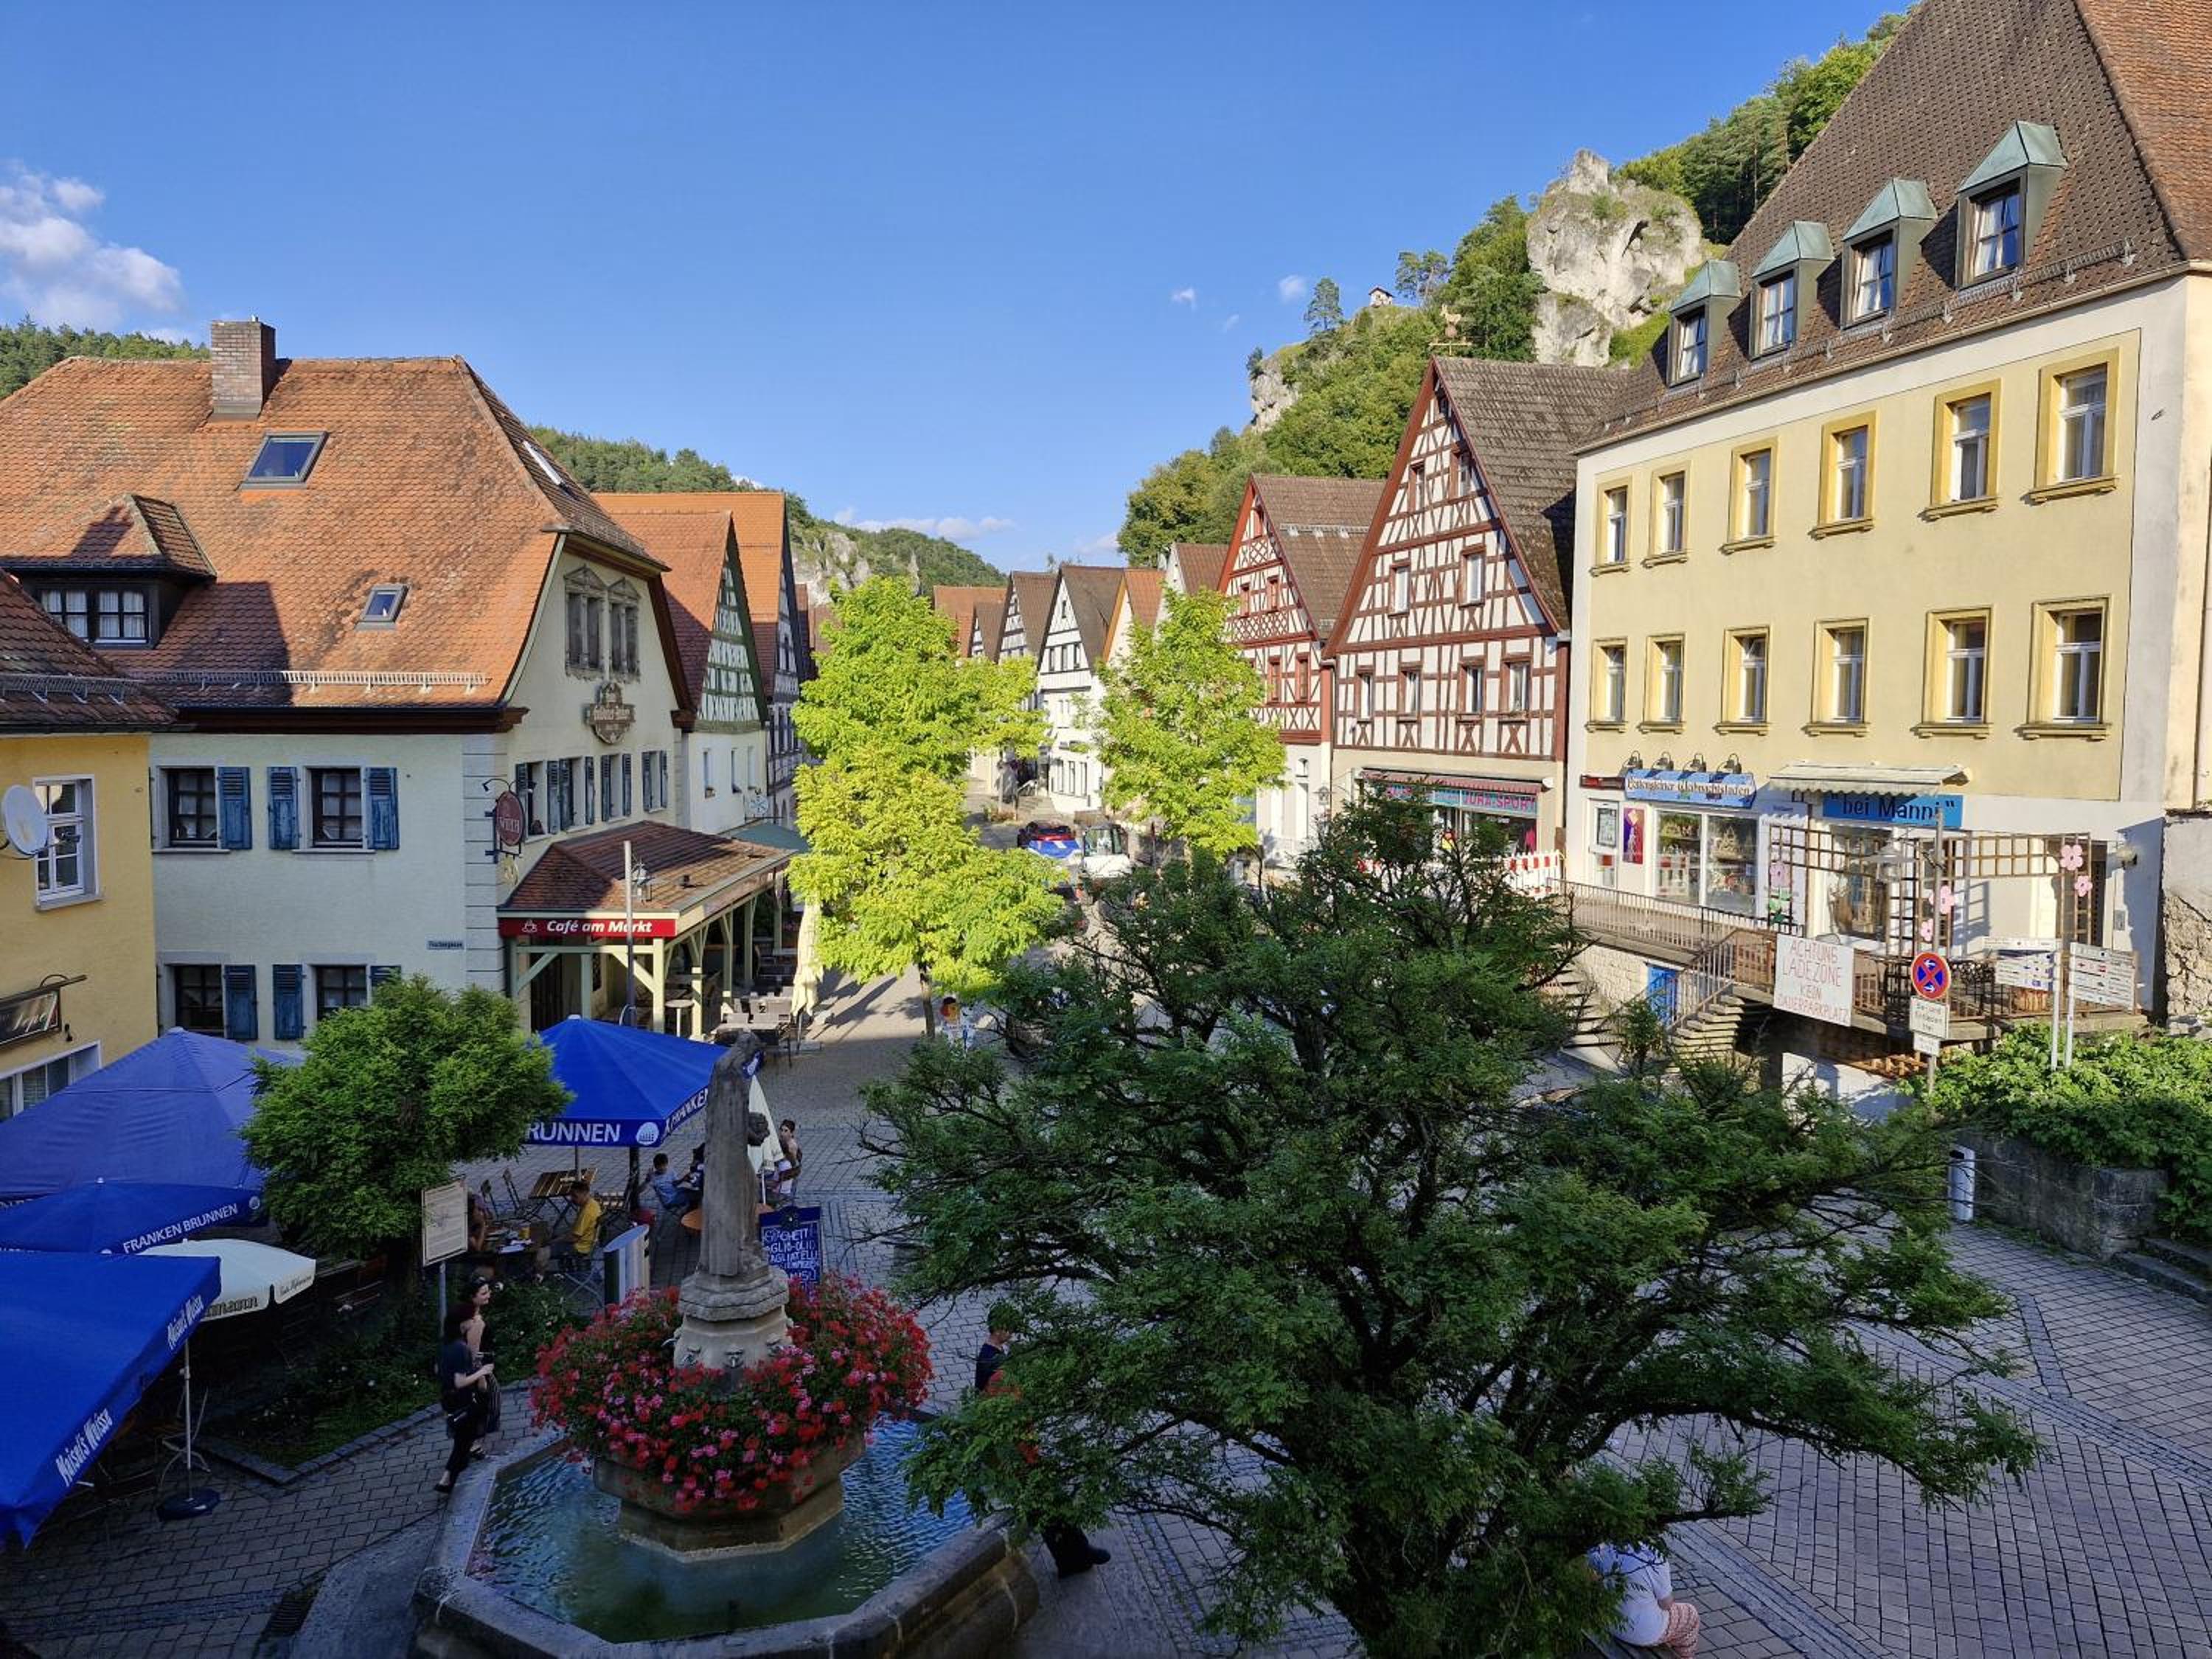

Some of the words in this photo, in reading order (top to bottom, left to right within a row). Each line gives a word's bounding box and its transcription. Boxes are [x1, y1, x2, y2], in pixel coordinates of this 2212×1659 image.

[546, 919, 579, 934] Café
[582, 923, 605, 933] am
[1782, 956, 1842, 987] LADEZONE
[524, 1121, 621, 1142] RUNNEN
[123, 1223, 182, 1253] FRANKEN
[183, 1203, 238, 1232] BRUNNEN
